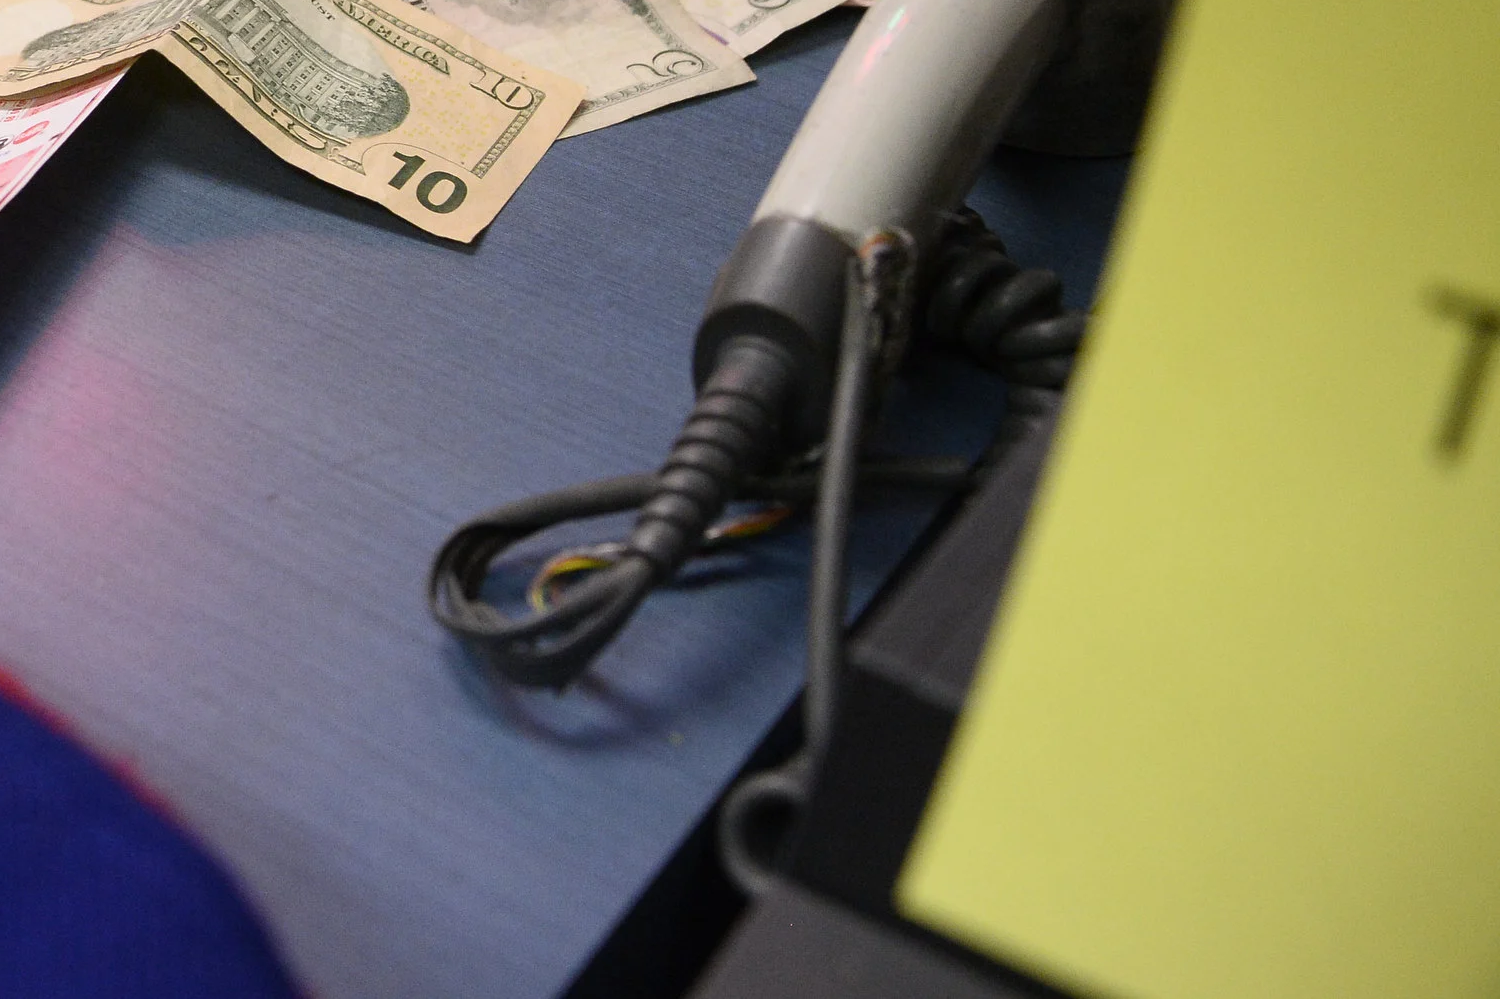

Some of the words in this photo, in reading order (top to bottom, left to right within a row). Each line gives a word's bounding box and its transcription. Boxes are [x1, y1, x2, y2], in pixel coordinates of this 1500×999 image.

[626, 49, 704, 78] 5
[470, 70, 535, 110] 10
[387, 151, 467, 214] 10
